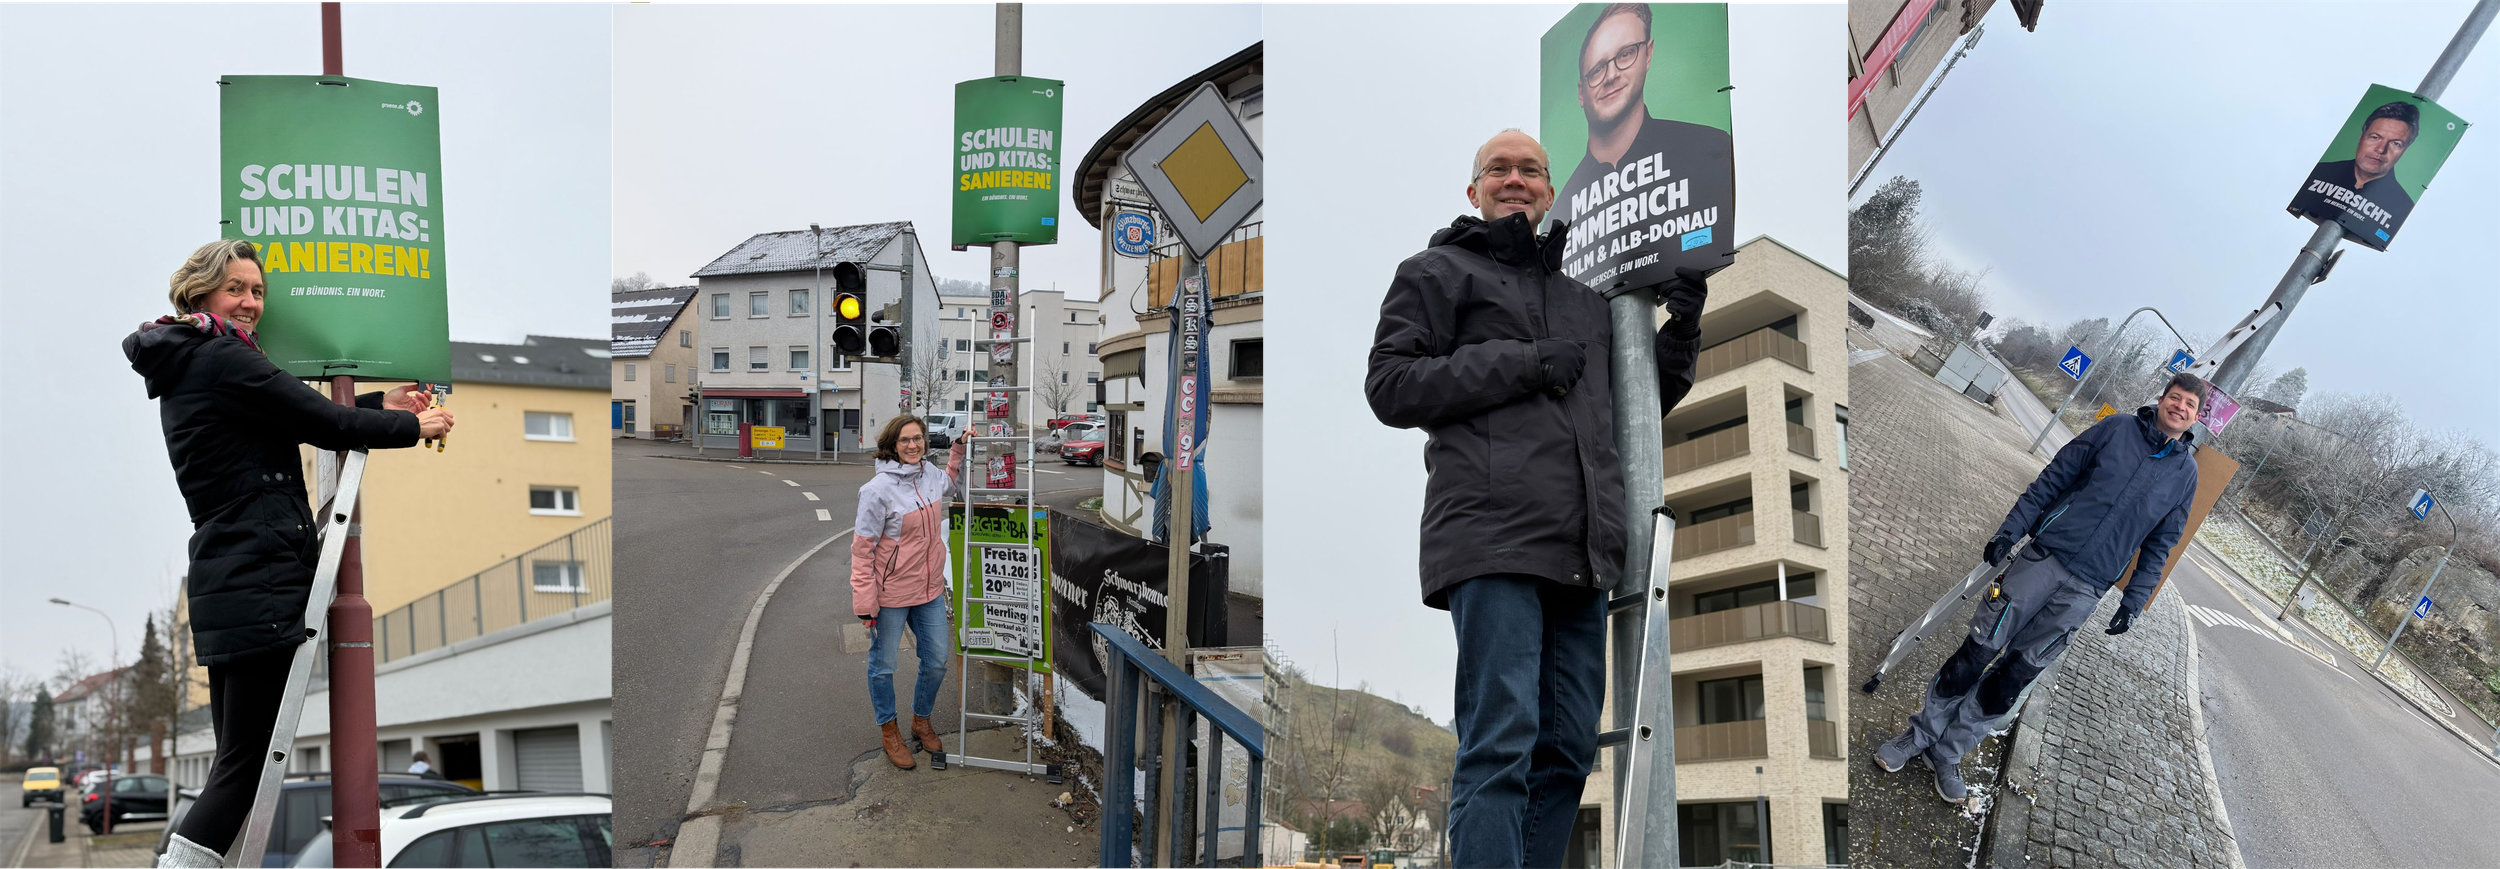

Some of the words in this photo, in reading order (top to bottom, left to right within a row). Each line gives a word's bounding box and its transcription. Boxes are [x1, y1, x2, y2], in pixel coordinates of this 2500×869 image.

[960, 127, 1053, 152] SCHULEN
[960, 152, 995, 171] UND
[999, 150, 1052, 170] KITAS:
[239, 163, 428, 207] SCHULEN
[960, 170, 1052, 191] SANIEREN!
[1571, 151, 1670, 222] MARCEL
[2308, 179, 2392, 229] ZUVERSICHT.
[240, 206, 314, 237] UND
[323, 206, 430, 243] KITAS:
[1562, 178, 1689, 262] EMMERICH
[1569, 249, 1595, 279] ULM
[1596, 246, 1607, 264] &
[1609, 206, 1718, 258] ALB-DONAU
[1590, 266, 1618, 288] MENSCH.
[1619, 260, 1633, 274] EIN
[1634, 252, 1660, 270] WORT.
[290, 287, 305, 296] EIN
[306, 285, 345, 297] BÜNDNIS.
[346, 287, 361, 297] EIN
[362, 288, 386, 298] WORT.
[953, 513, 1043, 541] BRGERBAL
[984, 547, 1037, 567] Freita
[986, 605, 1039, 624] Herrlingn
[986, 620, 1014, 630] Vorverkauf
